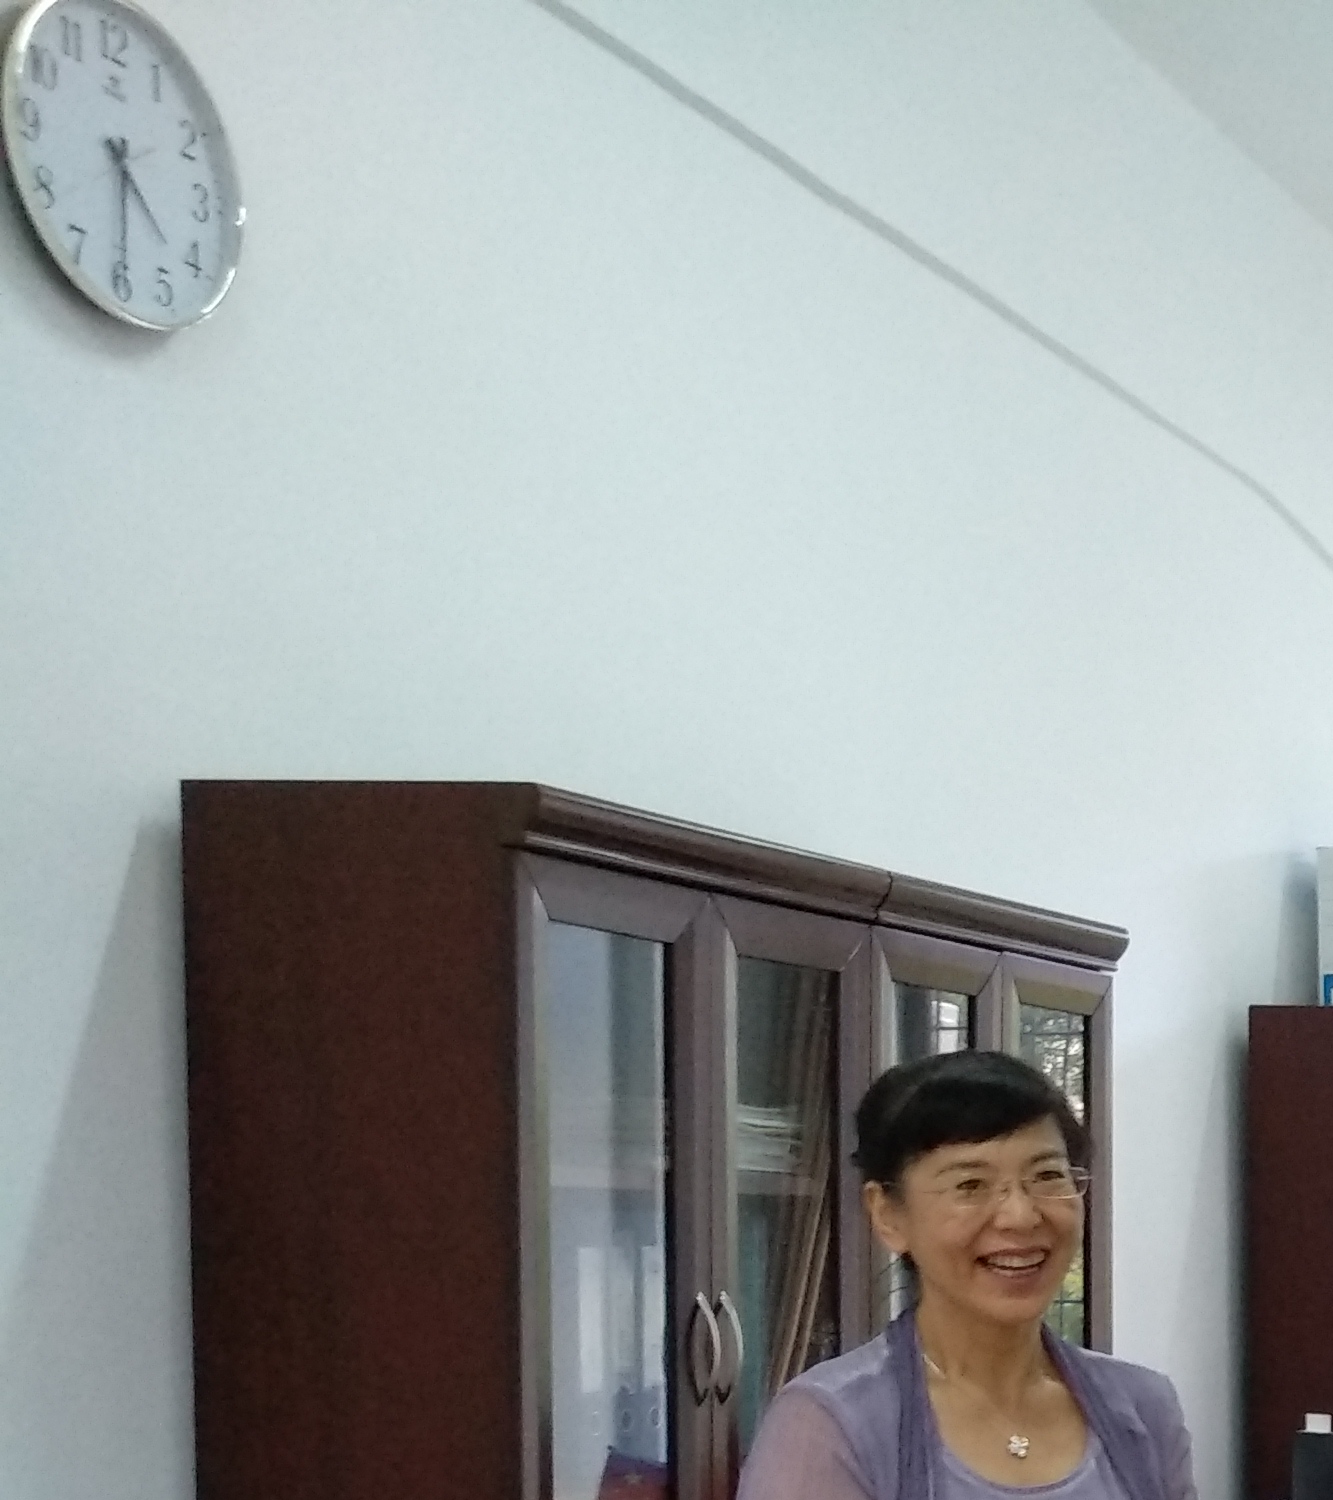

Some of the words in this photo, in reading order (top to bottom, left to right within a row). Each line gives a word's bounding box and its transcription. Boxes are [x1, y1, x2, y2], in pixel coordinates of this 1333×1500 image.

[59, 15, 82, 62] 11
[100, 18, 128, 68] 12
[152, 63, 162, 102] 1
[21, 97, 41, 142] 9
[178, 118, 197, 161] 2
[191, 183, 211, 223] 3
[67, 222, 88, 265] 7
[184, 240, 203, 278] 4
[111, 259, 133, 303] 6
[155, 265, 174, 307] 5
